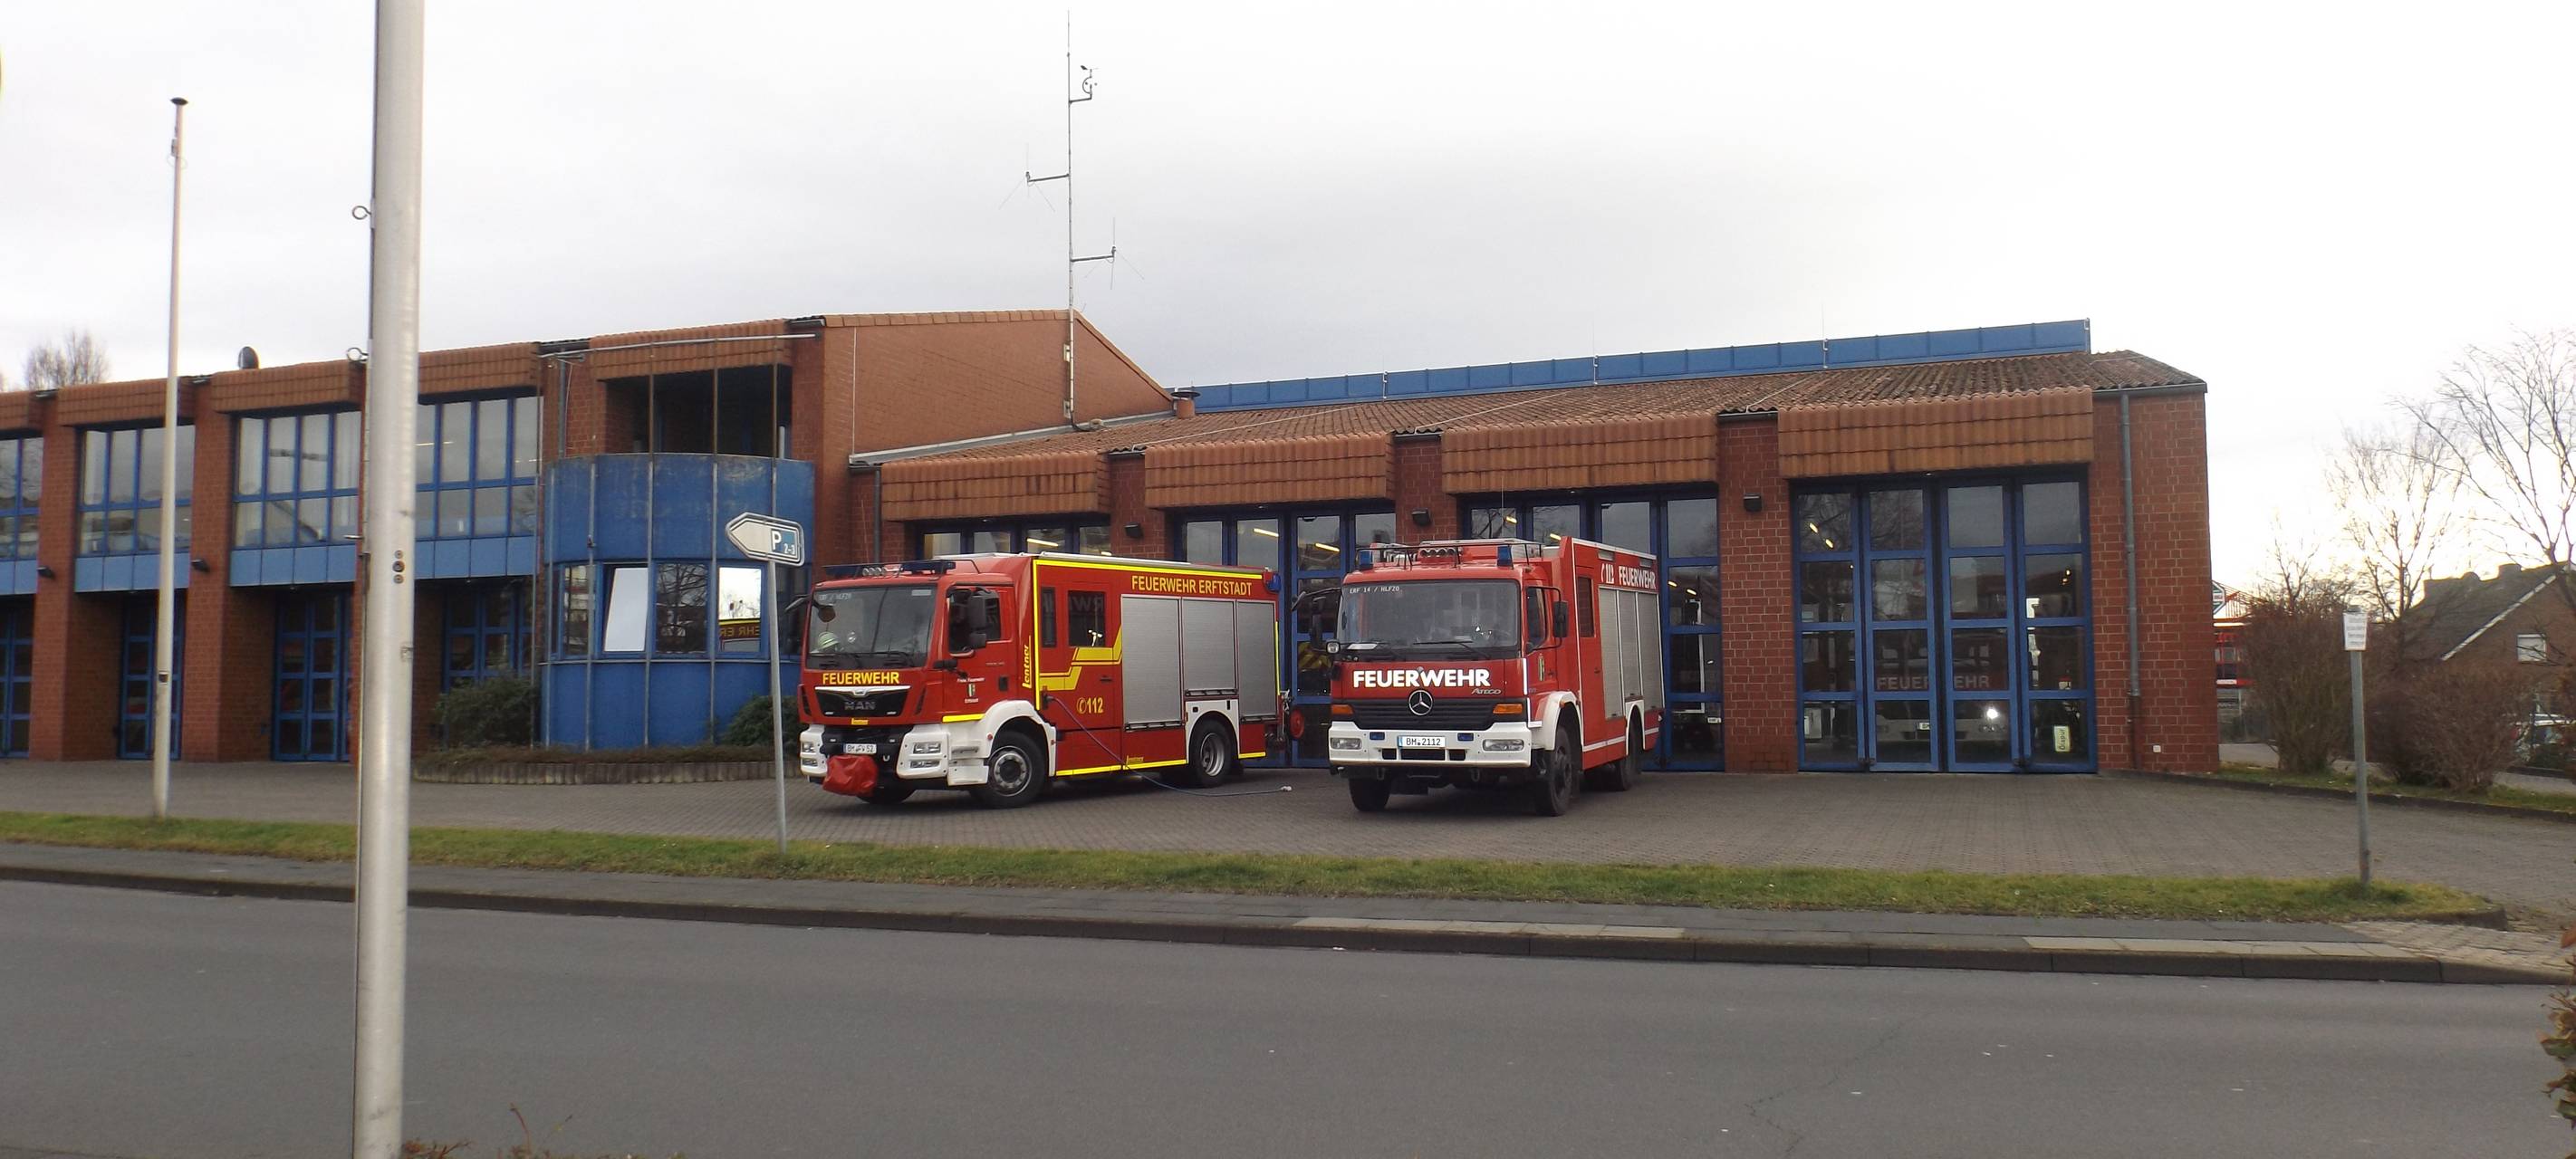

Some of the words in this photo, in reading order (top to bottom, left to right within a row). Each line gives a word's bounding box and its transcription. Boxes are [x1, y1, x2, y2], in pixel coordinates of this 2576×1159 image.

[772, 530, 782, 551] P
[1131, 575, 1197, 594] FEUERWEHR
[1198, 580, 1253, 596] ERFTSTADT
[1618, 565, 1657, 589] FEUERWEHR
[822, 671, 900, 685] FEUERWEHR
[1352, 669, 1491, 688] FEUERWEHR
[844, 701, 876, 711] MAN
[1086, 697, 1104, 714] 112
